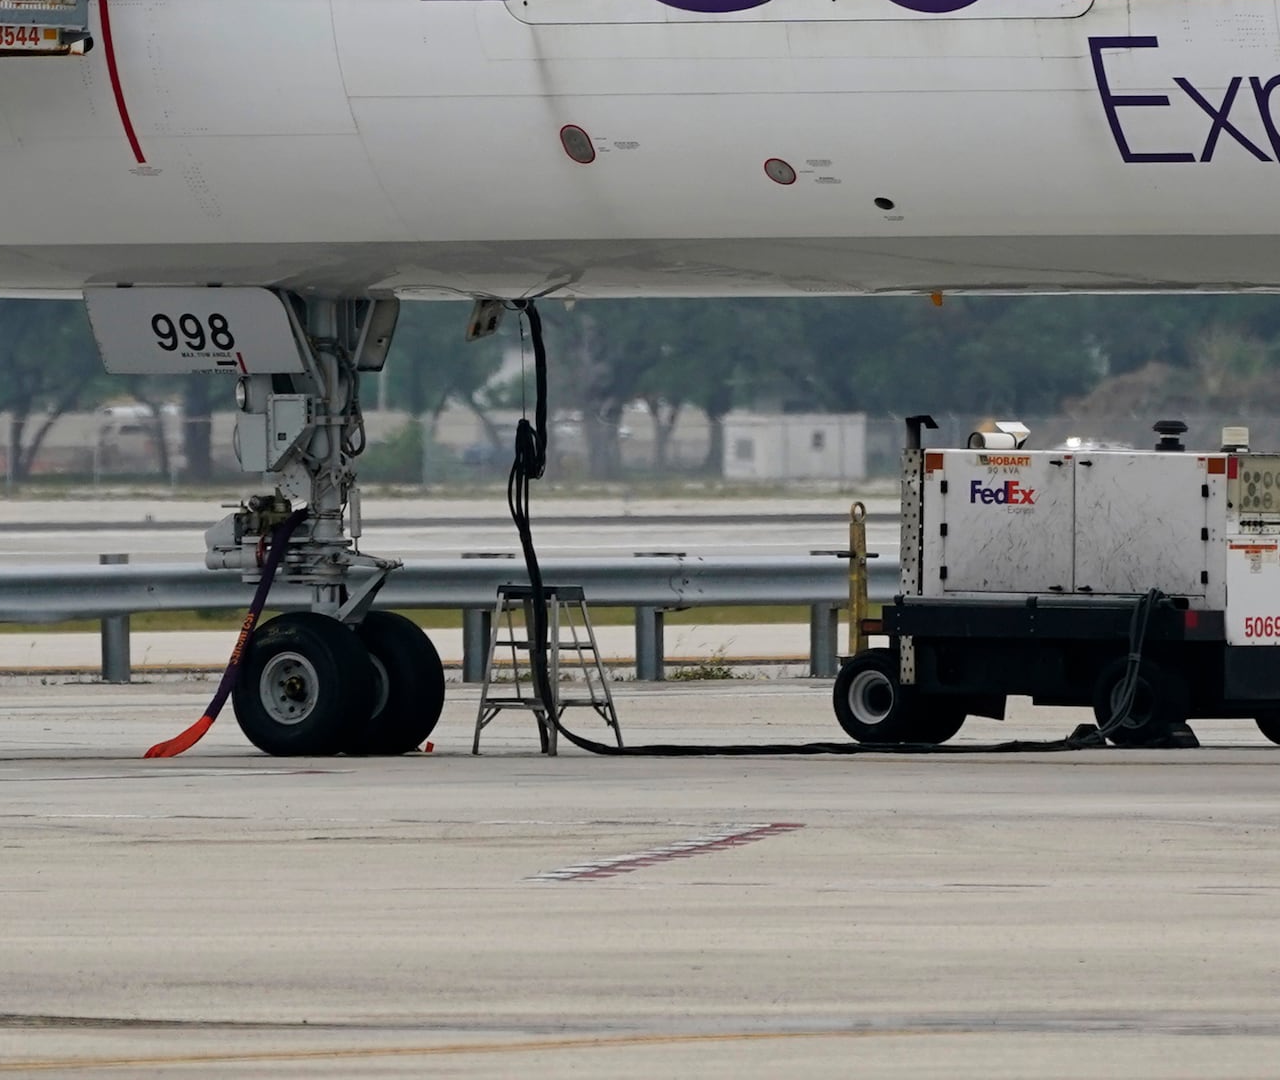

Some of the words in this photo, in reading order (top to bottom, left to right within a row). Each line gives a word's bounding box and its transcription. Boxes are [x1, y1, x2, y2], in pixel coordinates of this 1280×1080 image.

[151, 313, 235, 351] 998
[988, 456, 1030, 466] HOBART
[970, 480, 1035, 504] FedEx
